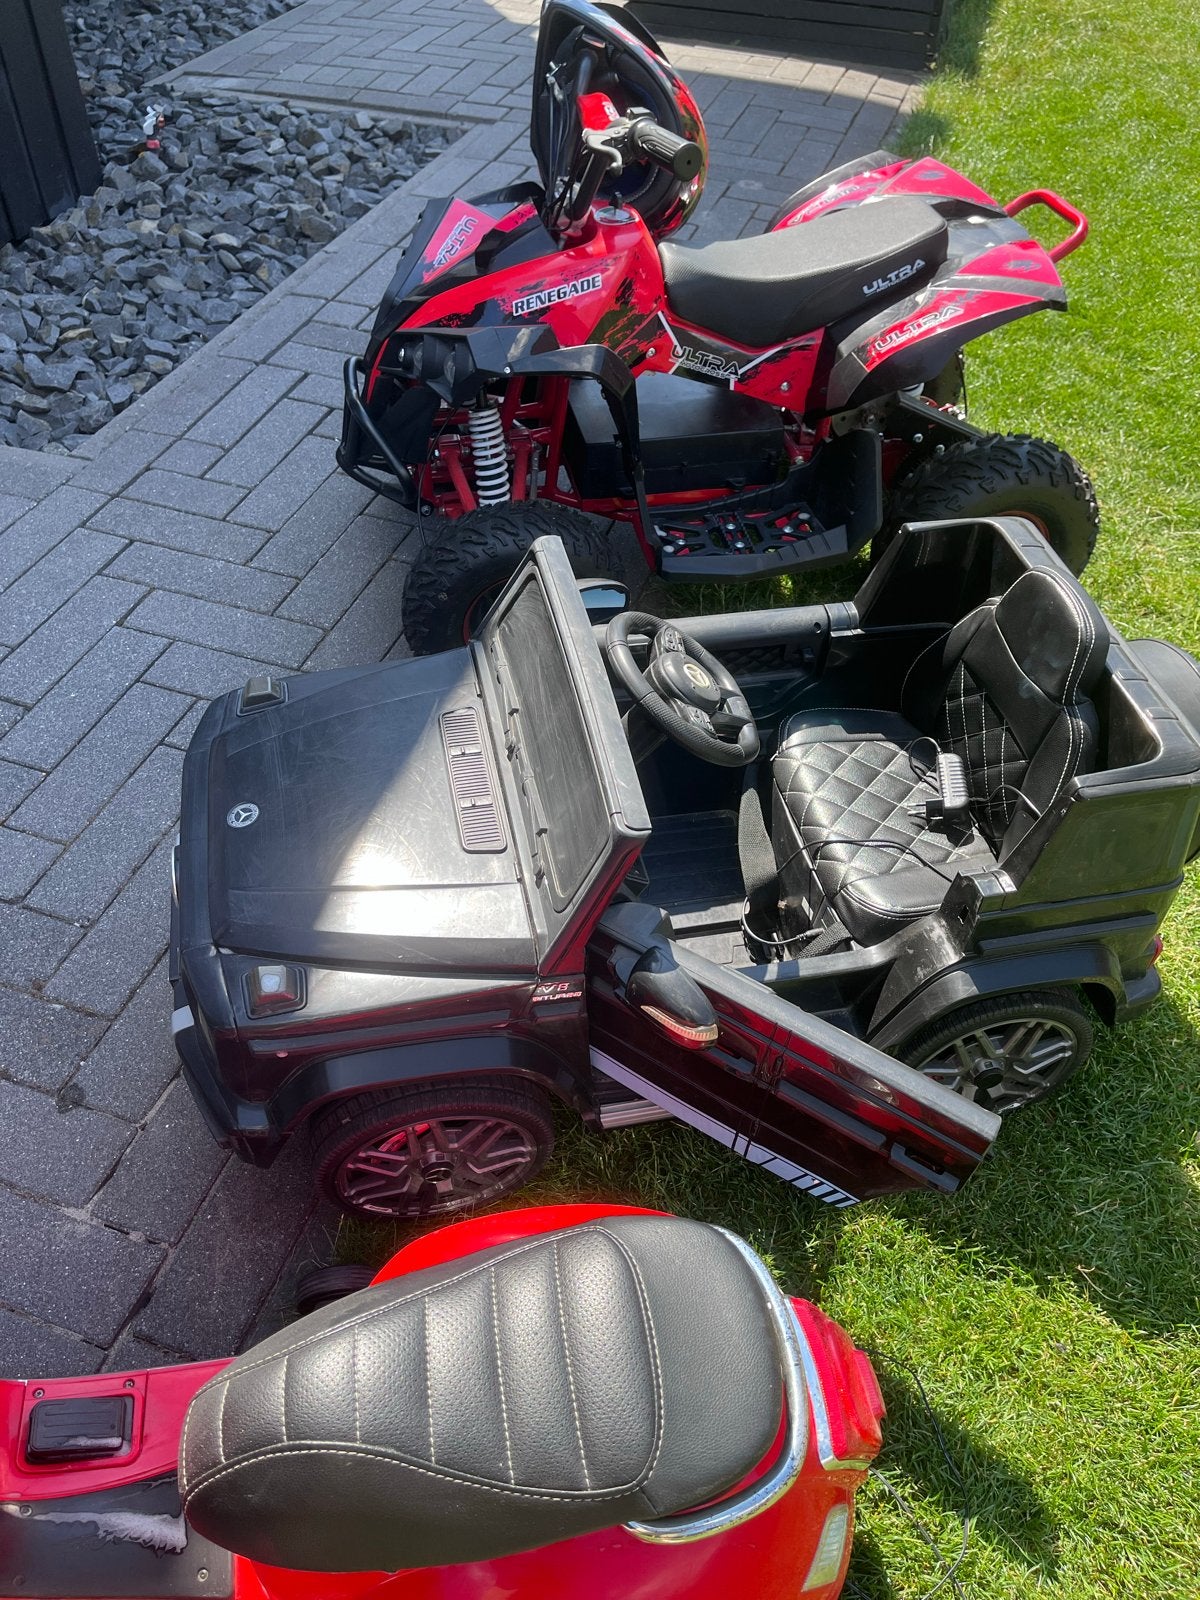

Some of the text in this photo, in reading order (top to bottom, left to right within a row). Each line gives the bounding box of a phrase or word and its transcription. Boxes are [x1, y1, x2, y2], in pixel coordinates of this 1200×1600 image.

[434, 216, 479, 267] ULTRA
[513, 274, 602, 316] RENEGADE
[862, 258, 926, 294] ULTRA
[875, 305, 964, 351] ULTRA
[670, 344, 740, 378] ULTRA
[680, 360, 728, 379] MOTOCROSS
